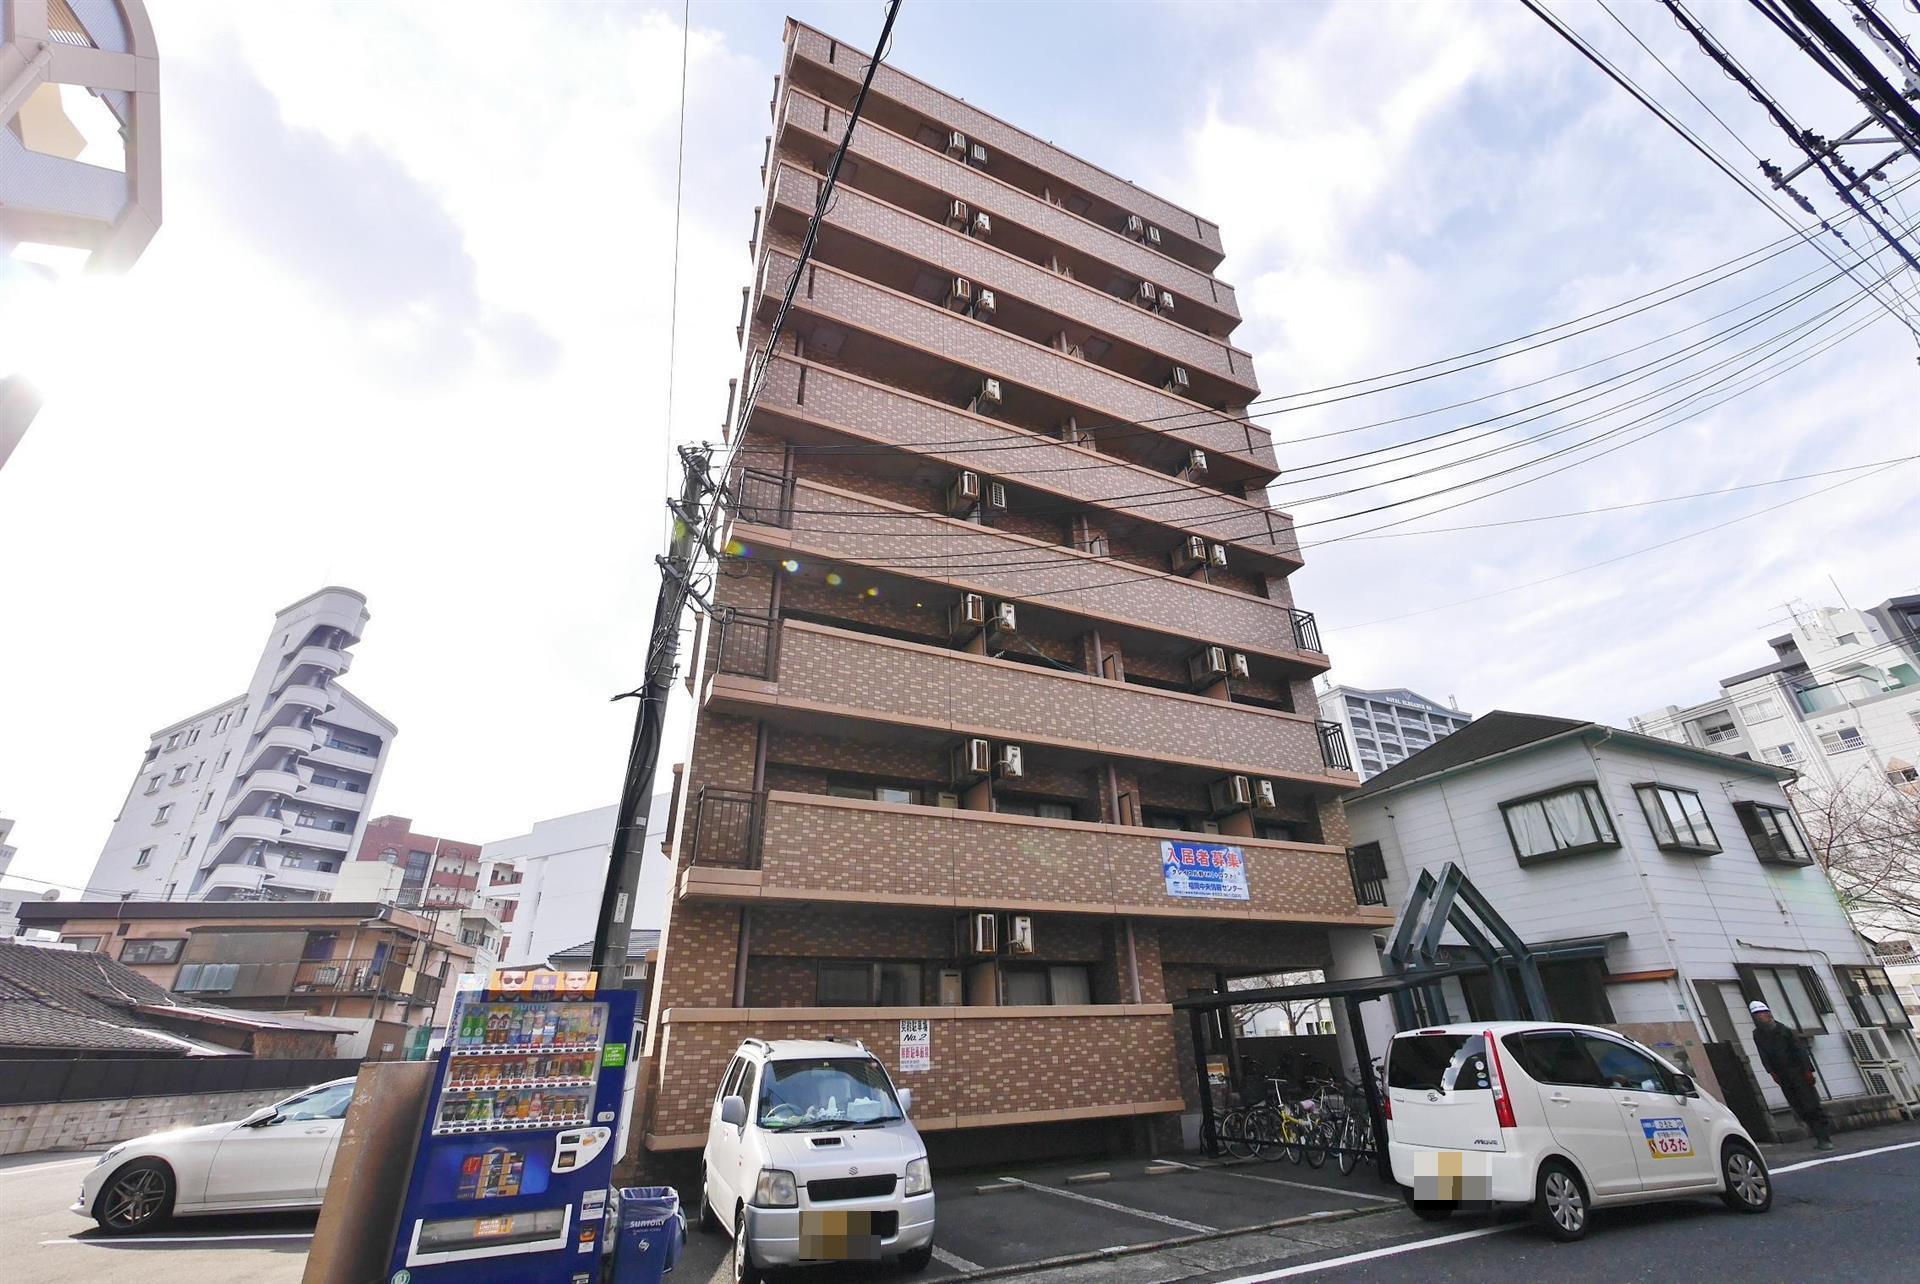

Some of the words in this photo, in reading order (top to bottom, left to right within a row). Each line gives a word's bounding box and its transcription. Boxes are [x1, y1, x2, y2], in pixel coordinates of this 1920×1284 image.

[1167, 847, 1241, 868] 入居者募集
[918, 1033, 927, 1041] 2
[1658, 1138, 1688, 1153] ひろた
[630, 1219, 665, 1228] SUNTORY
